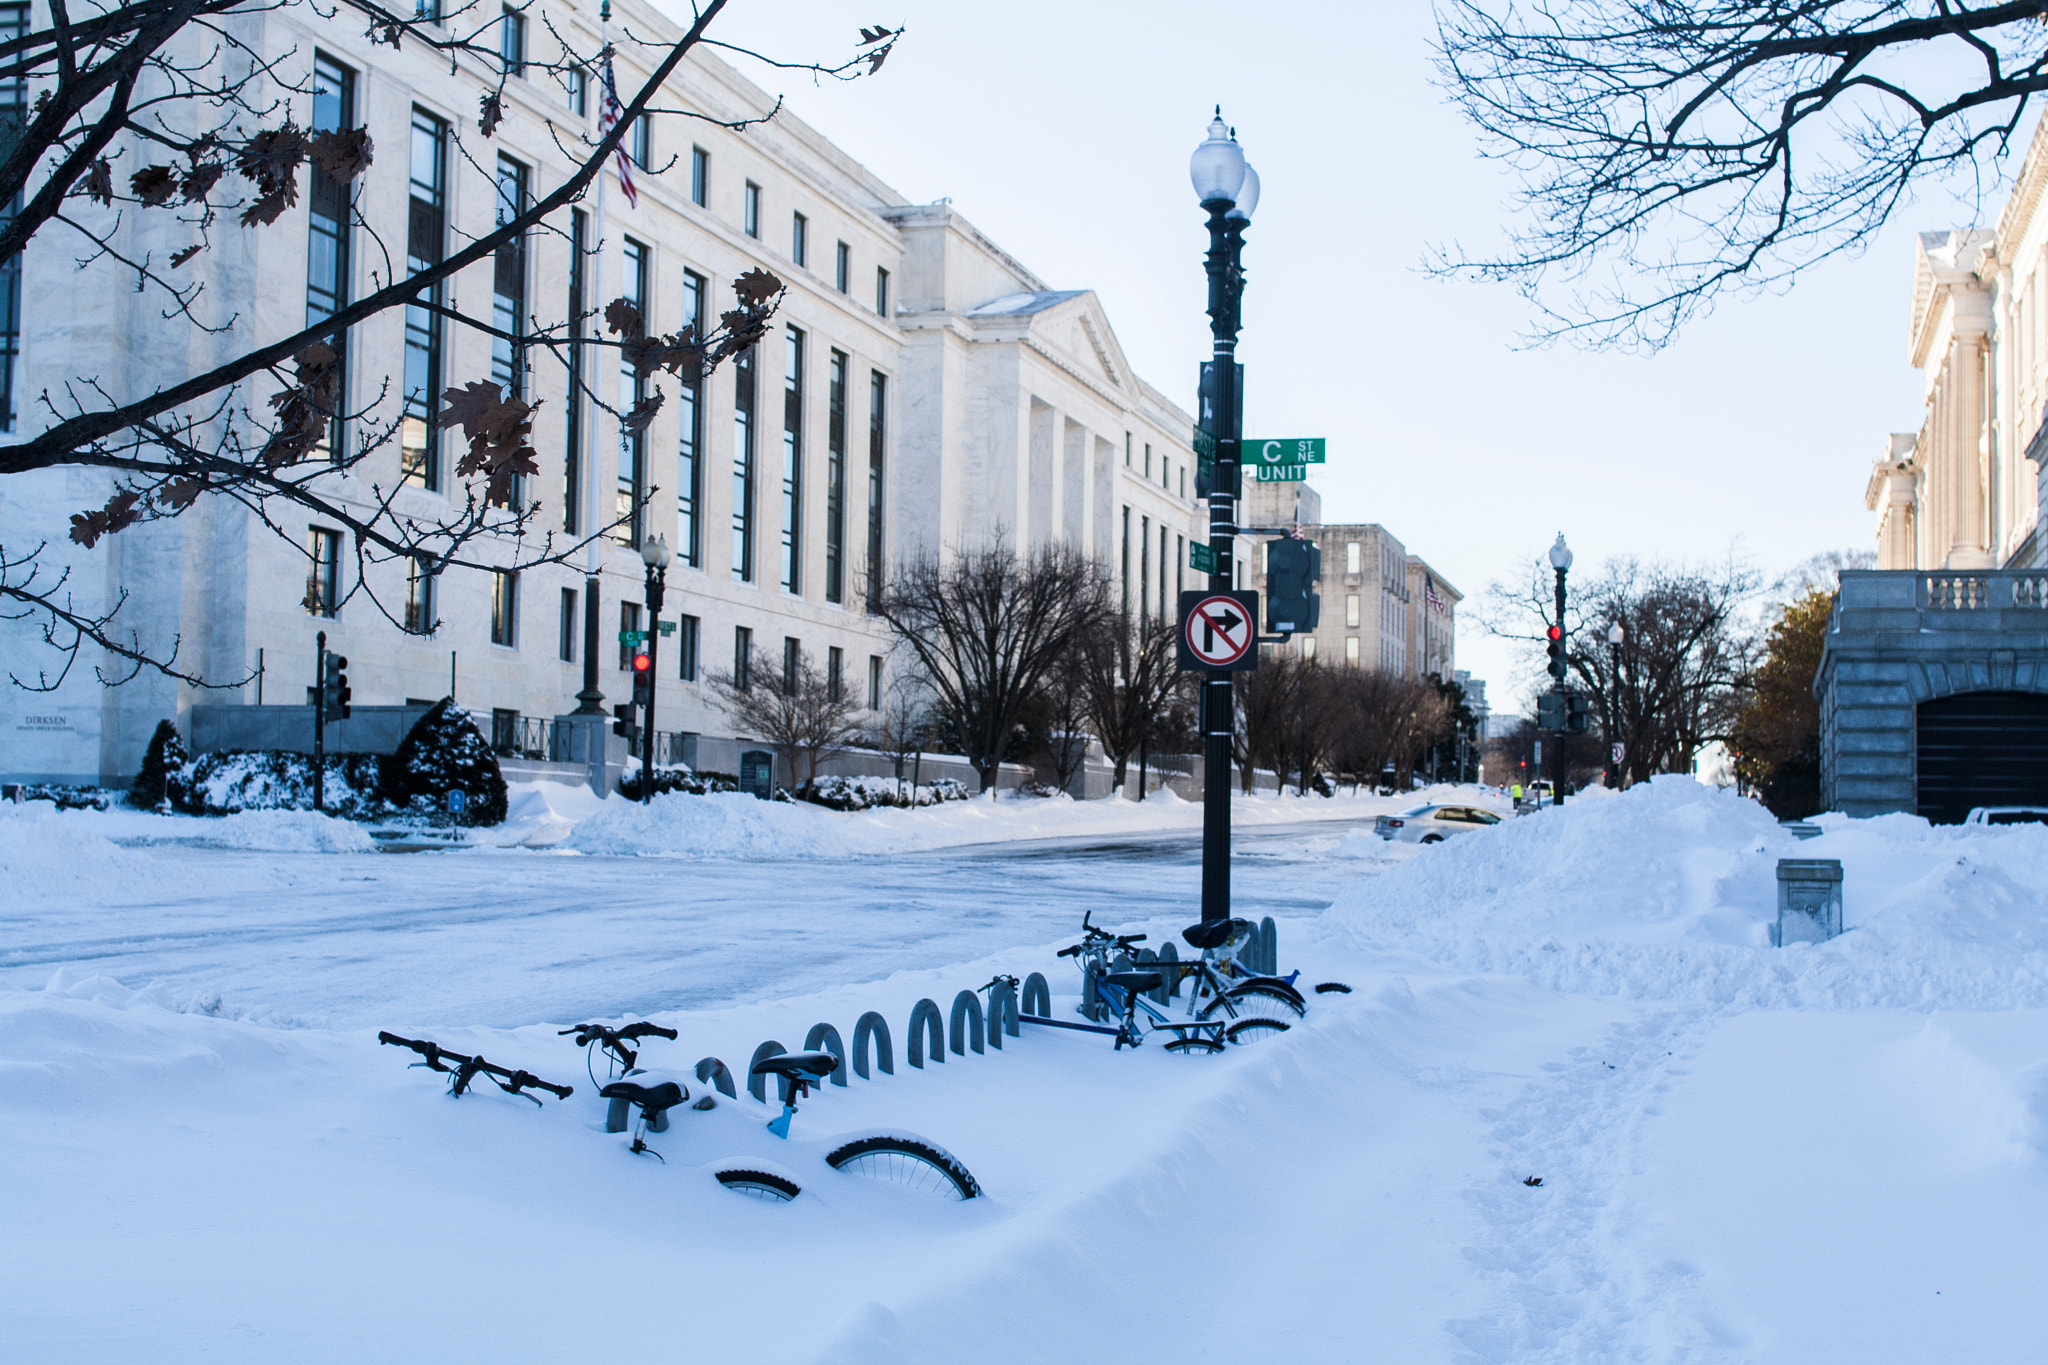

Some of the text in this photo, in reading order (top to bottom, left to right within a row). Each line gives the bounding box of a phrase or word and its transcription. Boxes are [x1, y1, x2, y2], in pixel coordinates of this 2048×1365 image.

[1299, 441, 1313, 451] ST
[1263, 441, 1281, 462] C
[1298, 451, 1315, 461] NE
[1259, 465, 1304, 480] UNIT
[626, 632, 634, 640] C
[25, 716, 66, 724] DIRKSEN
